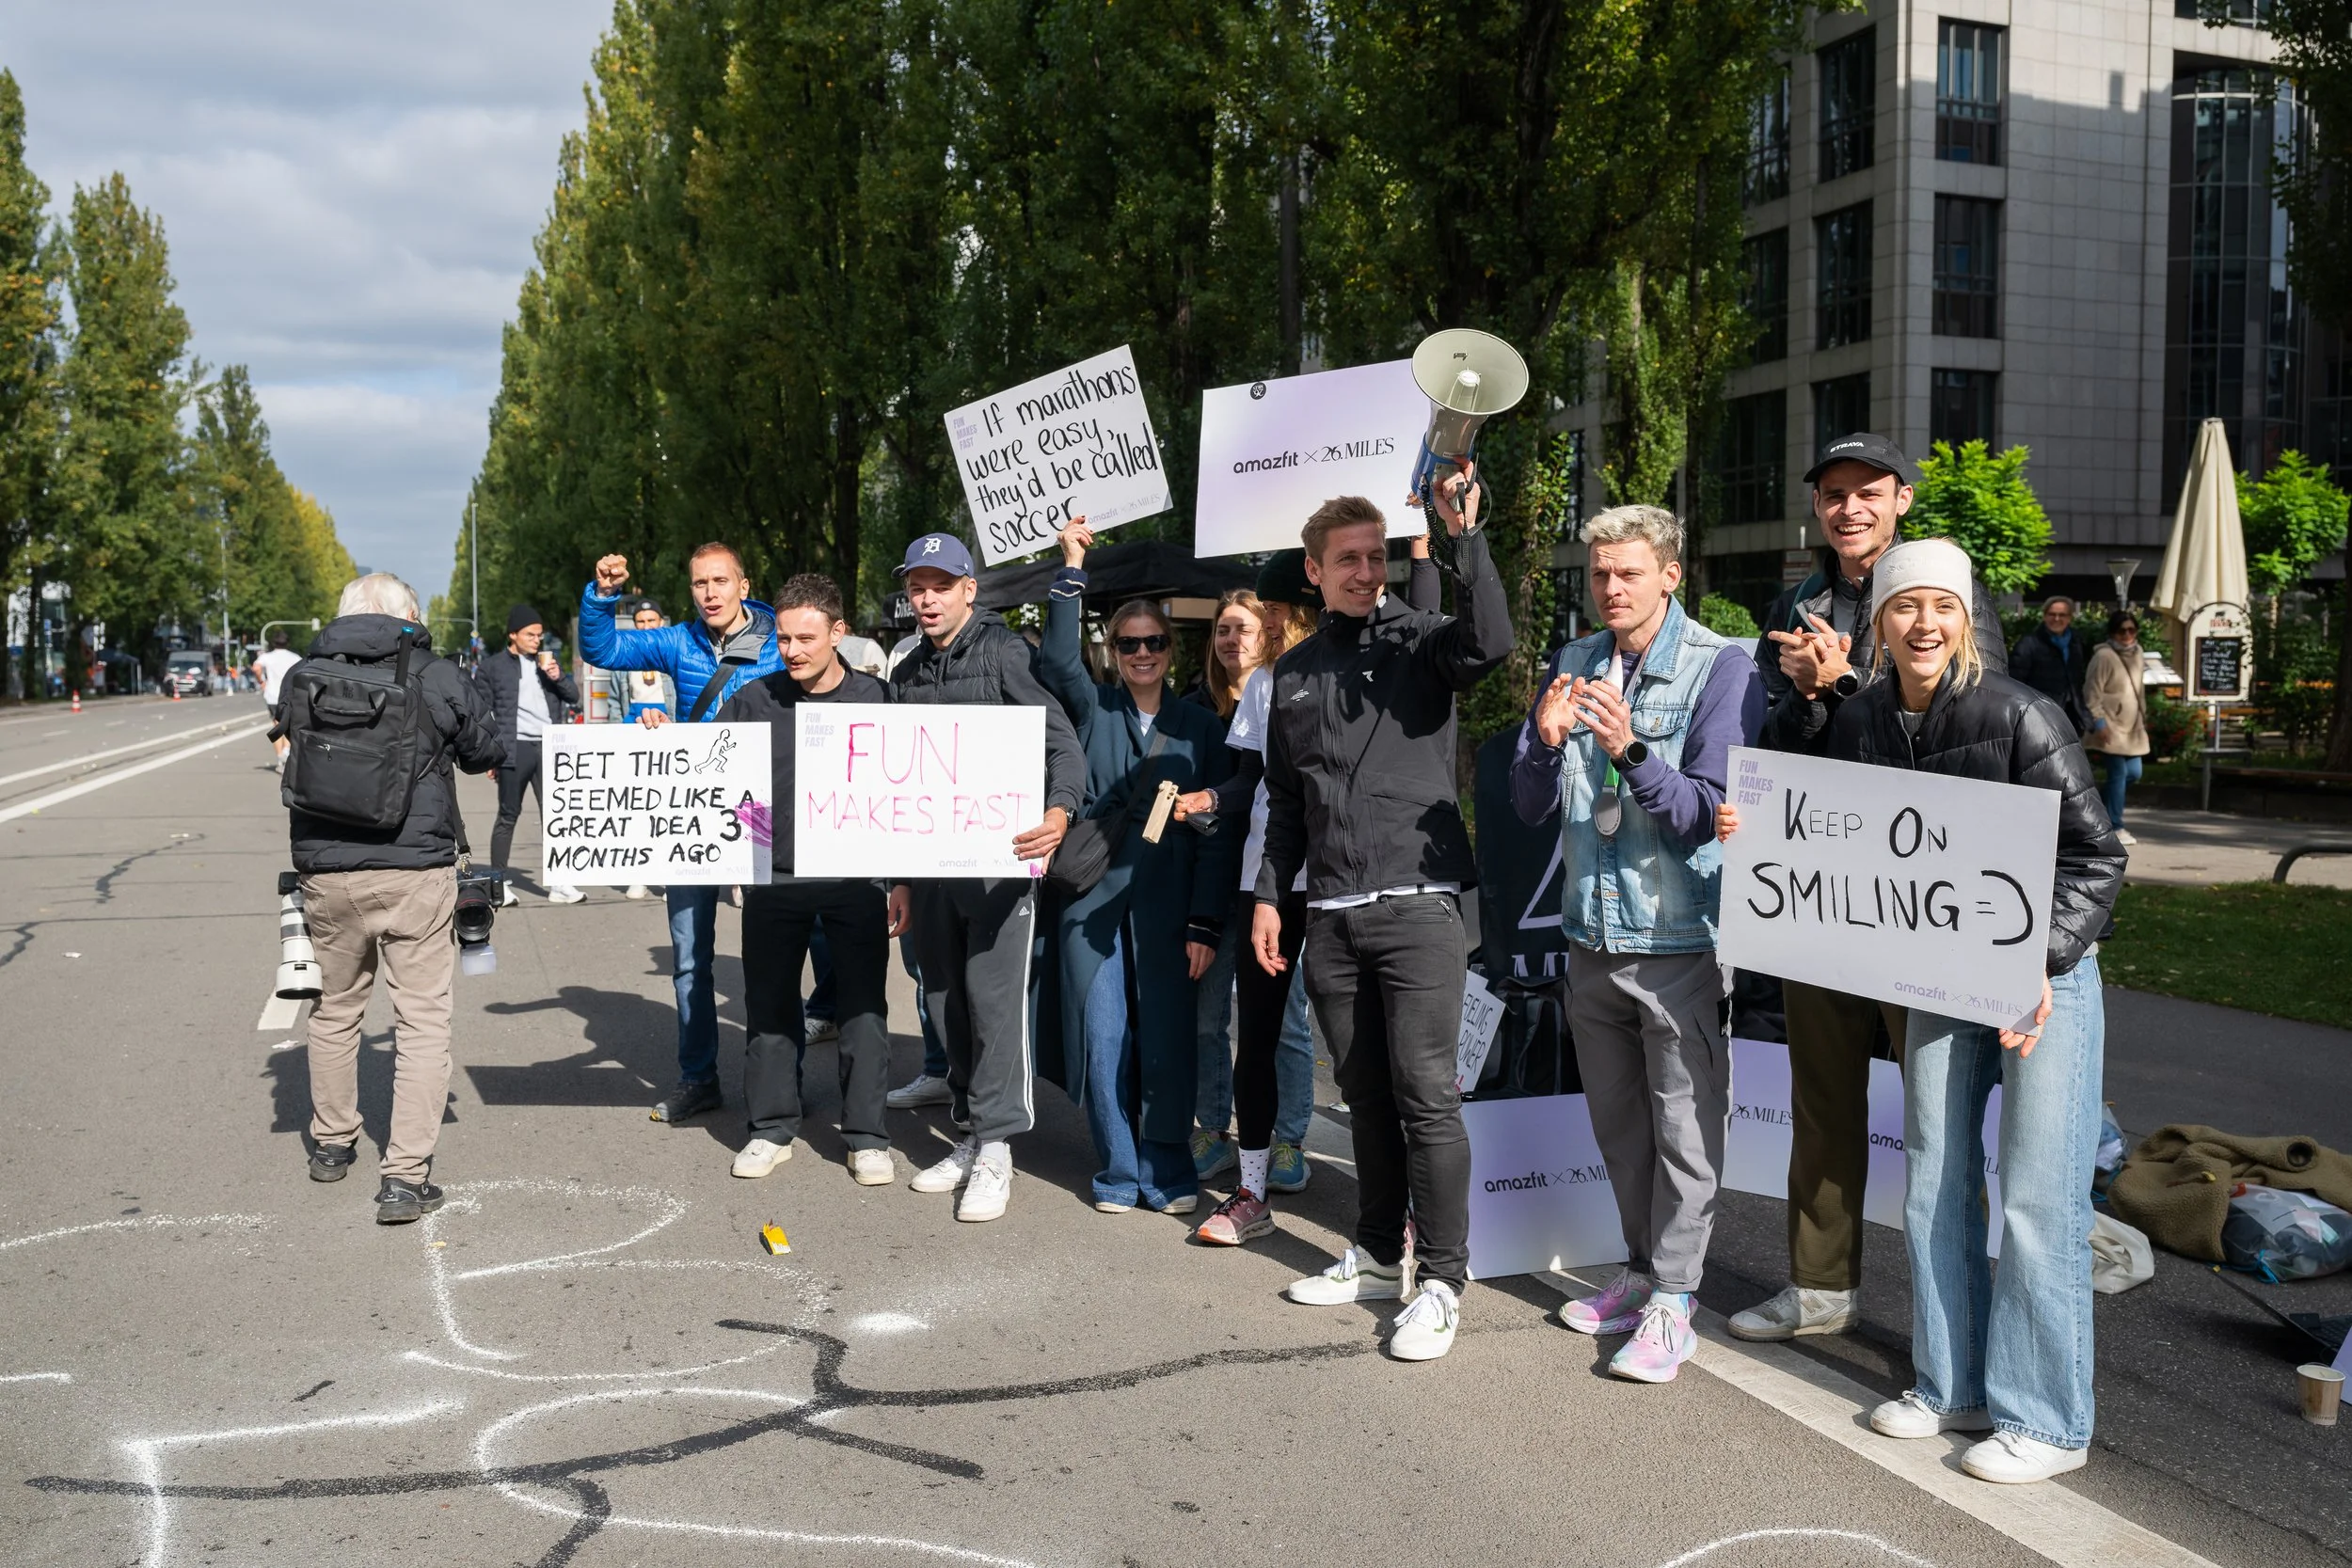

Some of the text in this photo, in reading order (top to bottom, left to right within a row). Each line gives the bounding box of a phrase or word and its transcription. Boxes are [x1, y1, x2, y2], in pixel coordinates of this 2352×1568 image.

[982, 365, 1136, 437] If marathons
[953, 416, 965, 429] FUN
[956, 423, 977, 440] MAKES
[959, 436, 974, 451] FAST
[1830, 442, 1865, 452] STRAVA
[966, 439, 1029, 481] were
[975, 422, 1158, 515] they'd be called
[1233, 451, 1298, 474] amazfit
[989, 496, 1078, 553] soccer
[804, 712, 821, 723] FUN
[804, 724, 834, 736] MAKES
[804, 736, 826, 748] FAST
[848, 722, 959, 784] FUN
[553, 748, 691, 783] BET THIS
[1739, 759, 1758, 774] FUN
[1738, 774, 1773, 792] MAKES
[551, 786, 755, 814] SEEMED LIKE A
[1738, 789, 1762, 806] FAST
[547, 808, 742, 842] GREAT IDEA 3
[808, 790, 1031, 834] MAKES FAST
[547, 842, 722, 872] MONTHS AGO
[1747, 862, 1960, 932] SMILING
[1894, 981, 1947, 1003] amazfit
[1458, 1029, 1486, 1074] POWER
[1484, 1168, 1549, 1194] amazfit
